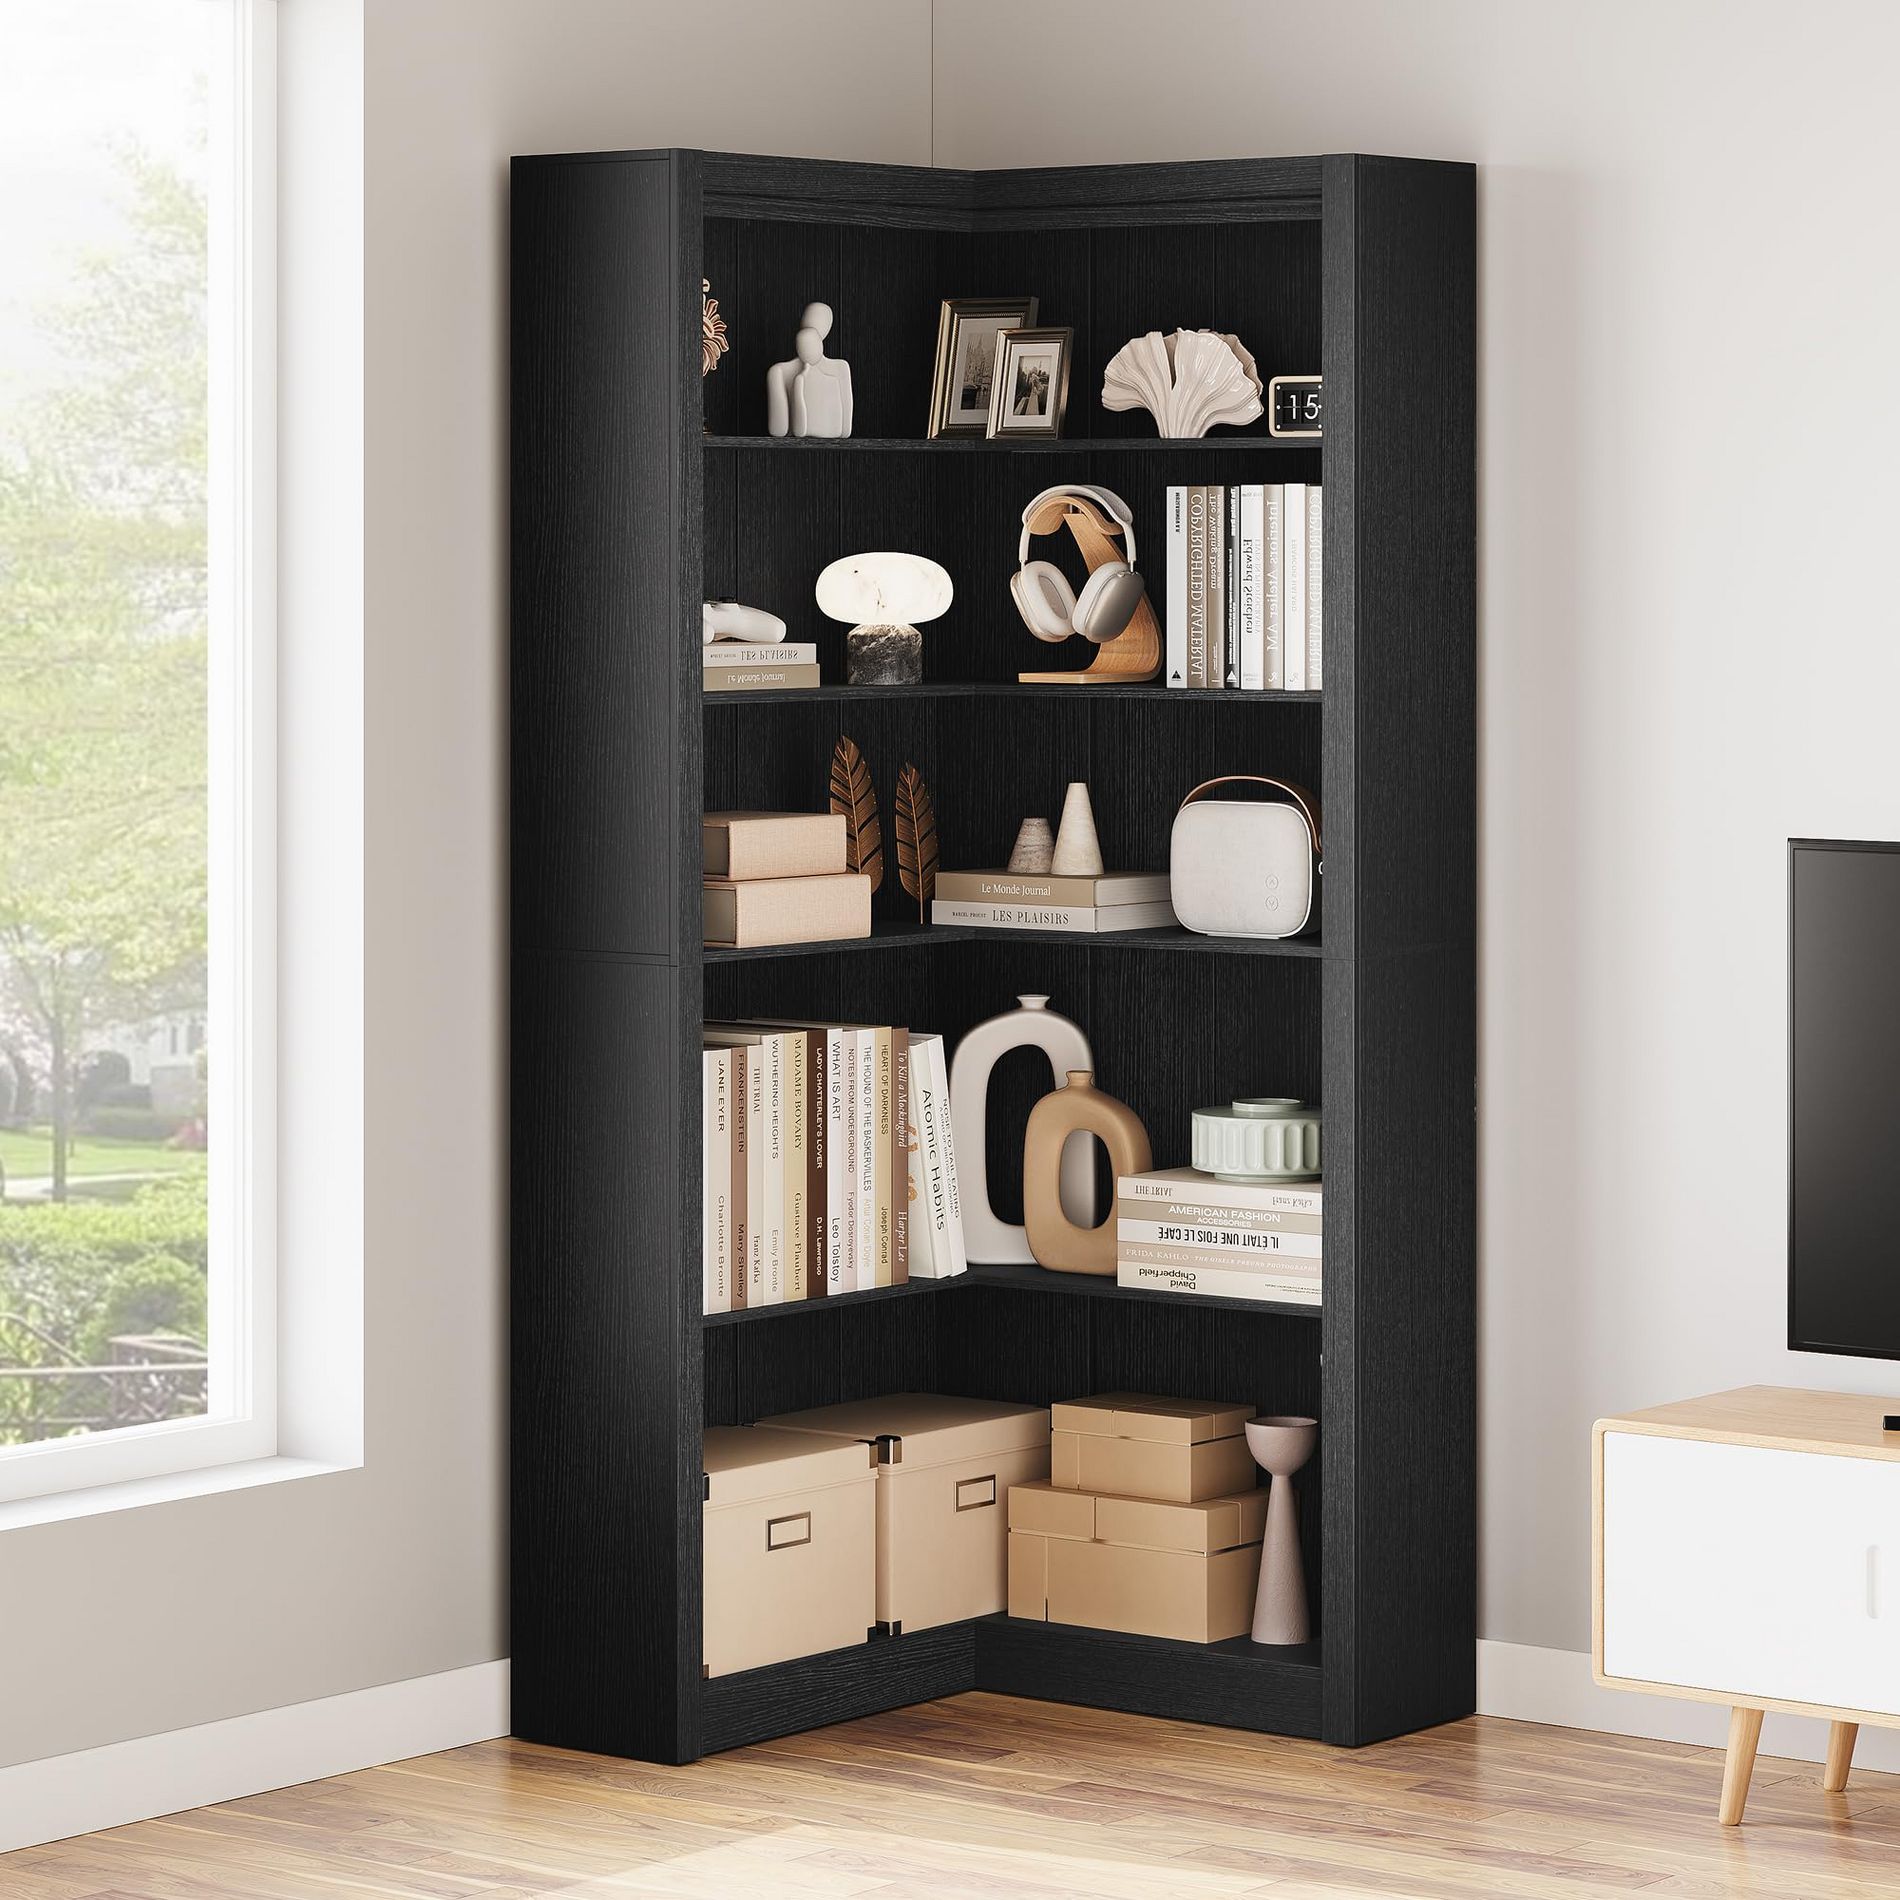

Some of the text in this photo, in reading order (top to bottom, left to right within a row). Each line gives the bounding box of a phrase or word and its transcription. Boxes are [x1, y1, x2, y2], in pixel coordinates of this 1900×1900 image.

[1290, 394, 1318, 419] 15
[982, 883, 1051, 896] Le Monde Journal
[992, 910, 1069, 925] LES PLAISIRS
[898, 1050, 907, 1062] To
[832, 1041, 841, 1121] WHAT IS ART
[898, 1065, 907, 1081] Kill
[881, 1044, 889, 1135] HEART OF DARKNESS
[864, 1097, 871, 1109] OF
[896, 1093, 907, 1148] Mockingbird
[922, 1089, 945, 1231] Atomic Habits
[943, 1099, 951, 1131] NOSE
[947, 1134, 953, 1148] TO
[952, 1177, 960, 1219] EATING
[880, 1206, 888, 1234] Joseph
[1168, 1206, 1280, 1222] AMERICAN FASHION
[1196, 1217, 1252, 1228] ACCESSORIES
[895, 1211, 907, 1262] Harper Lee
[1158, 1227, 1279, 1250] IL ÉTAIT UNE FOIS LE CAFÉ
[831, 1217, 841, 1282] Leo Tolstoy
[1126, 1249, 1153, 1257] FRIDA
[1157, 1251, 1189, 1260] KAHLO
[1139, 1268, 1196, 1280] Chipperfield
[1170, 1280, 1196, 1290] David
